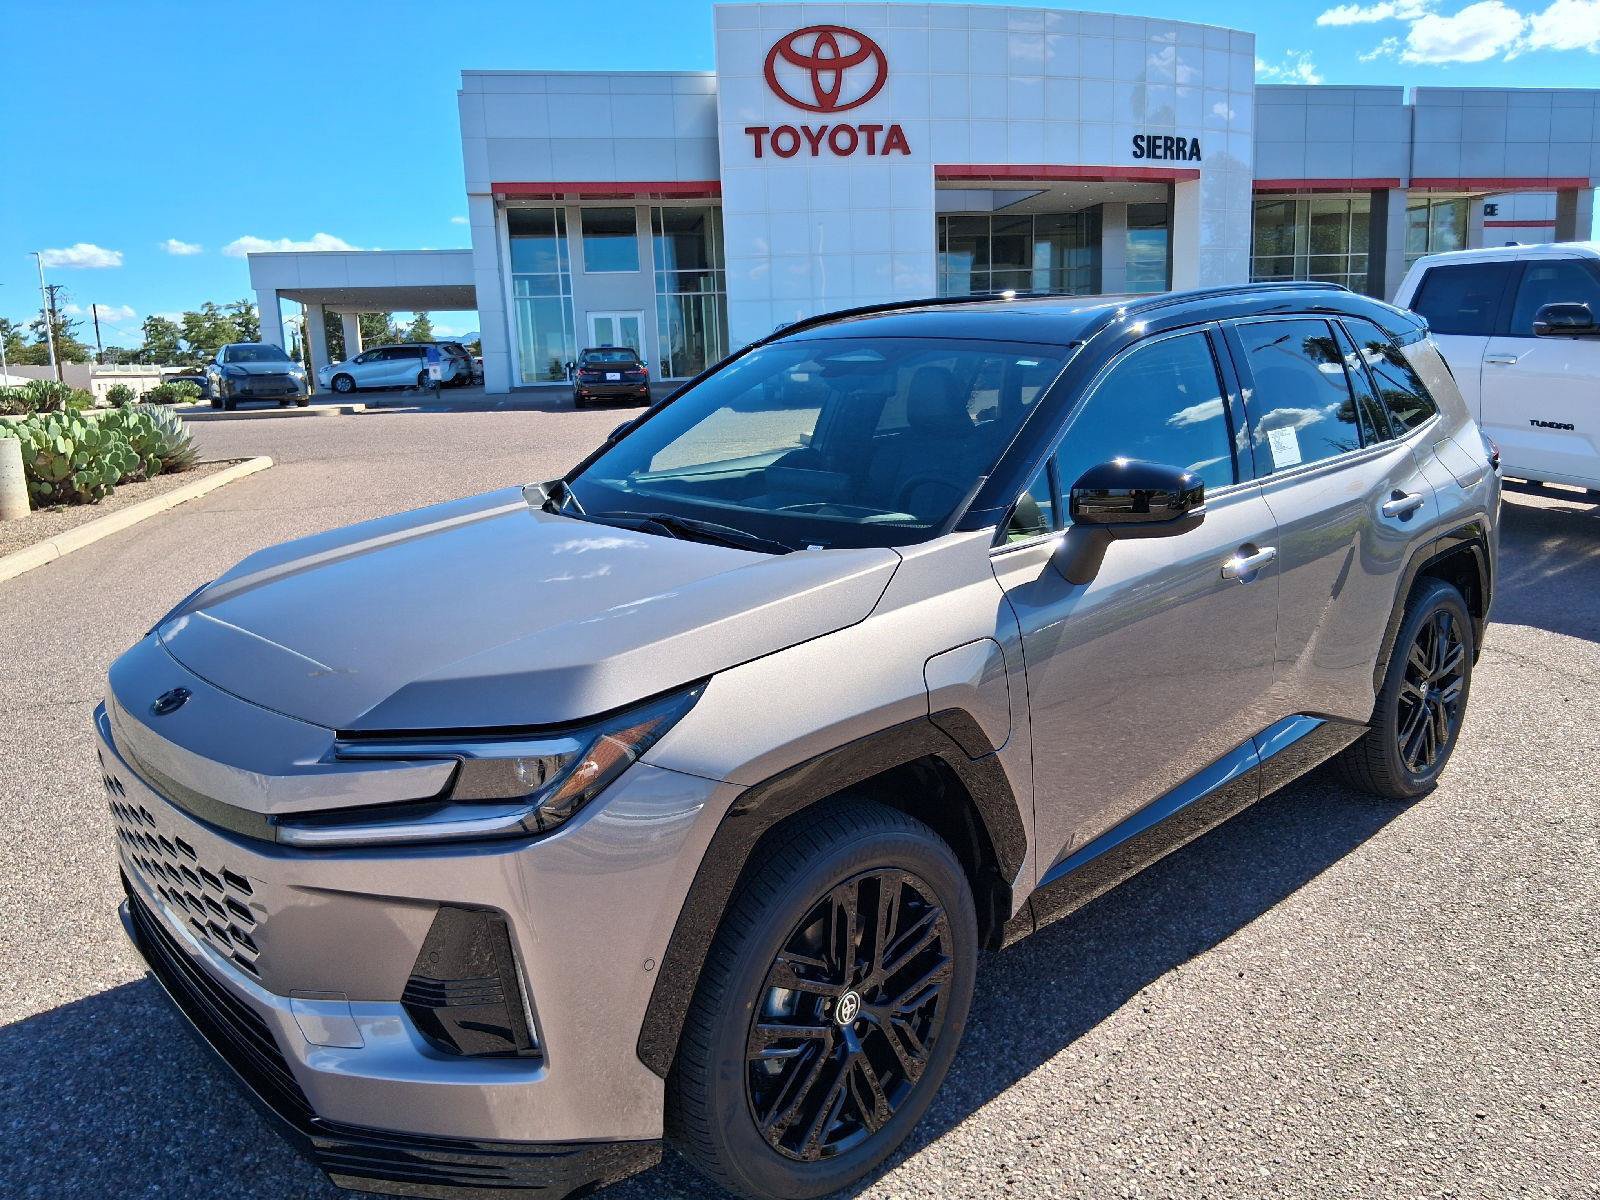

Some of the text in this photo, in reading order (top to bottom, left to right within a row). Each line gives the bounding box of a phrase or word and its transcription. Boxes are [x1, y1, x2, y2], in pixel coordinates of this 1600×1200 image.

[745, 124, 911, 159] TOYOTA
[1132, 134, 1202, 161] SIERRA
[1529, 419, 1575, 431] TUNDRA
